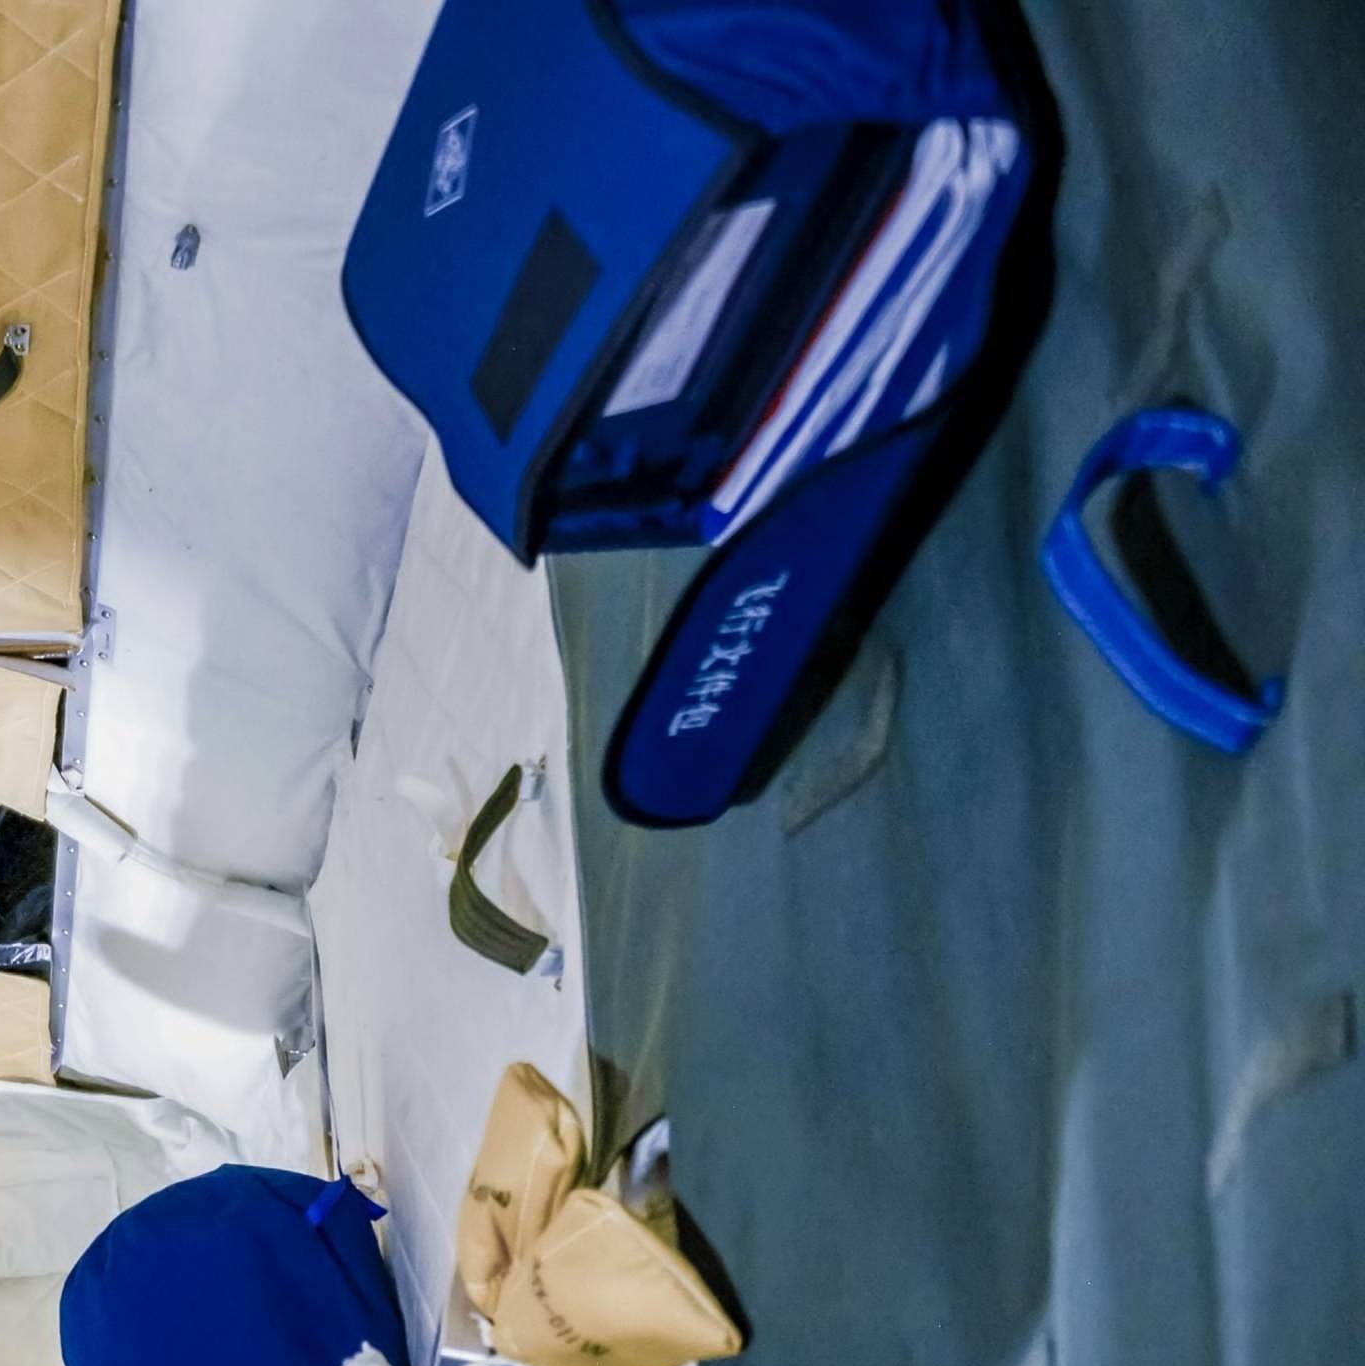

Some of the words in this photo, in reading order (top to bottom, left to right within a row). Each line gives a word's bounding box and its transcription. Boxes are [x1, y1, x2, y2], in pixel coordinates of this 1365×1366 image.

[668, 571, 790, 737] 飞行文件包
